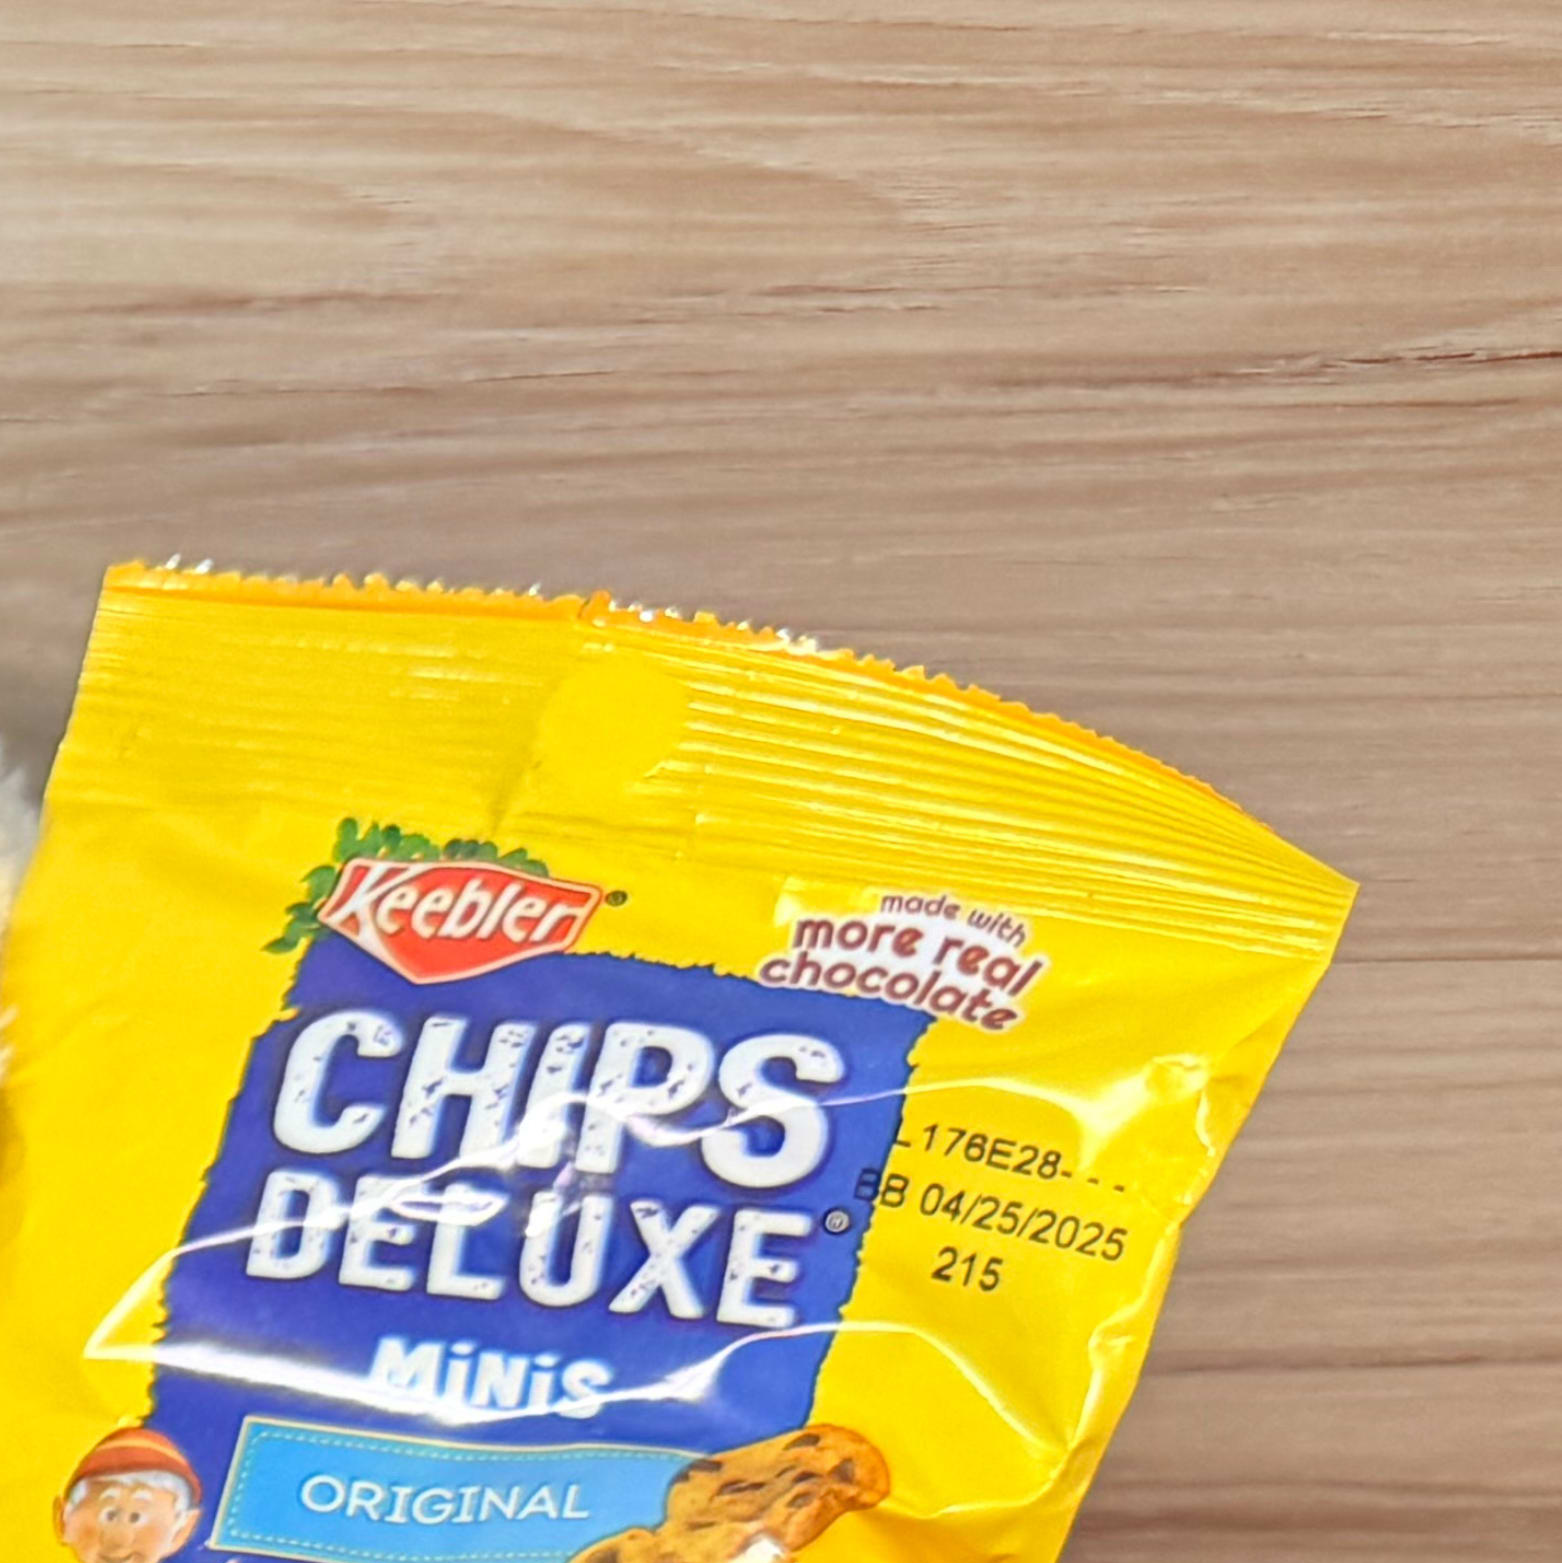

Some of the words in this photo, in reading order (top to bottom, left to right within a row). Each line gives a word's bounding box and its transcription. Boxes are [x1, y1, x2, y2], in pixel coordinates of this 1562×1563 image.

[332, 862, 575, 948] Keebler
[880, 893, 960, 921] made
[967, 905, 1027, 948] with
[759, 951, 1019, 1031] chocolate
[792, 918, 924, 959] more
[932, 934, 1043, 997] real
[273, 1008, 846, 1188] CHIPS
[245, 1169, 813, 1329] DELUXE
[918, 1182, 1128, 1262] 04/25/2025
[931, 1245, 1004, 1292] 215
[299, 1474, 590, 1526] ORIGINAL
